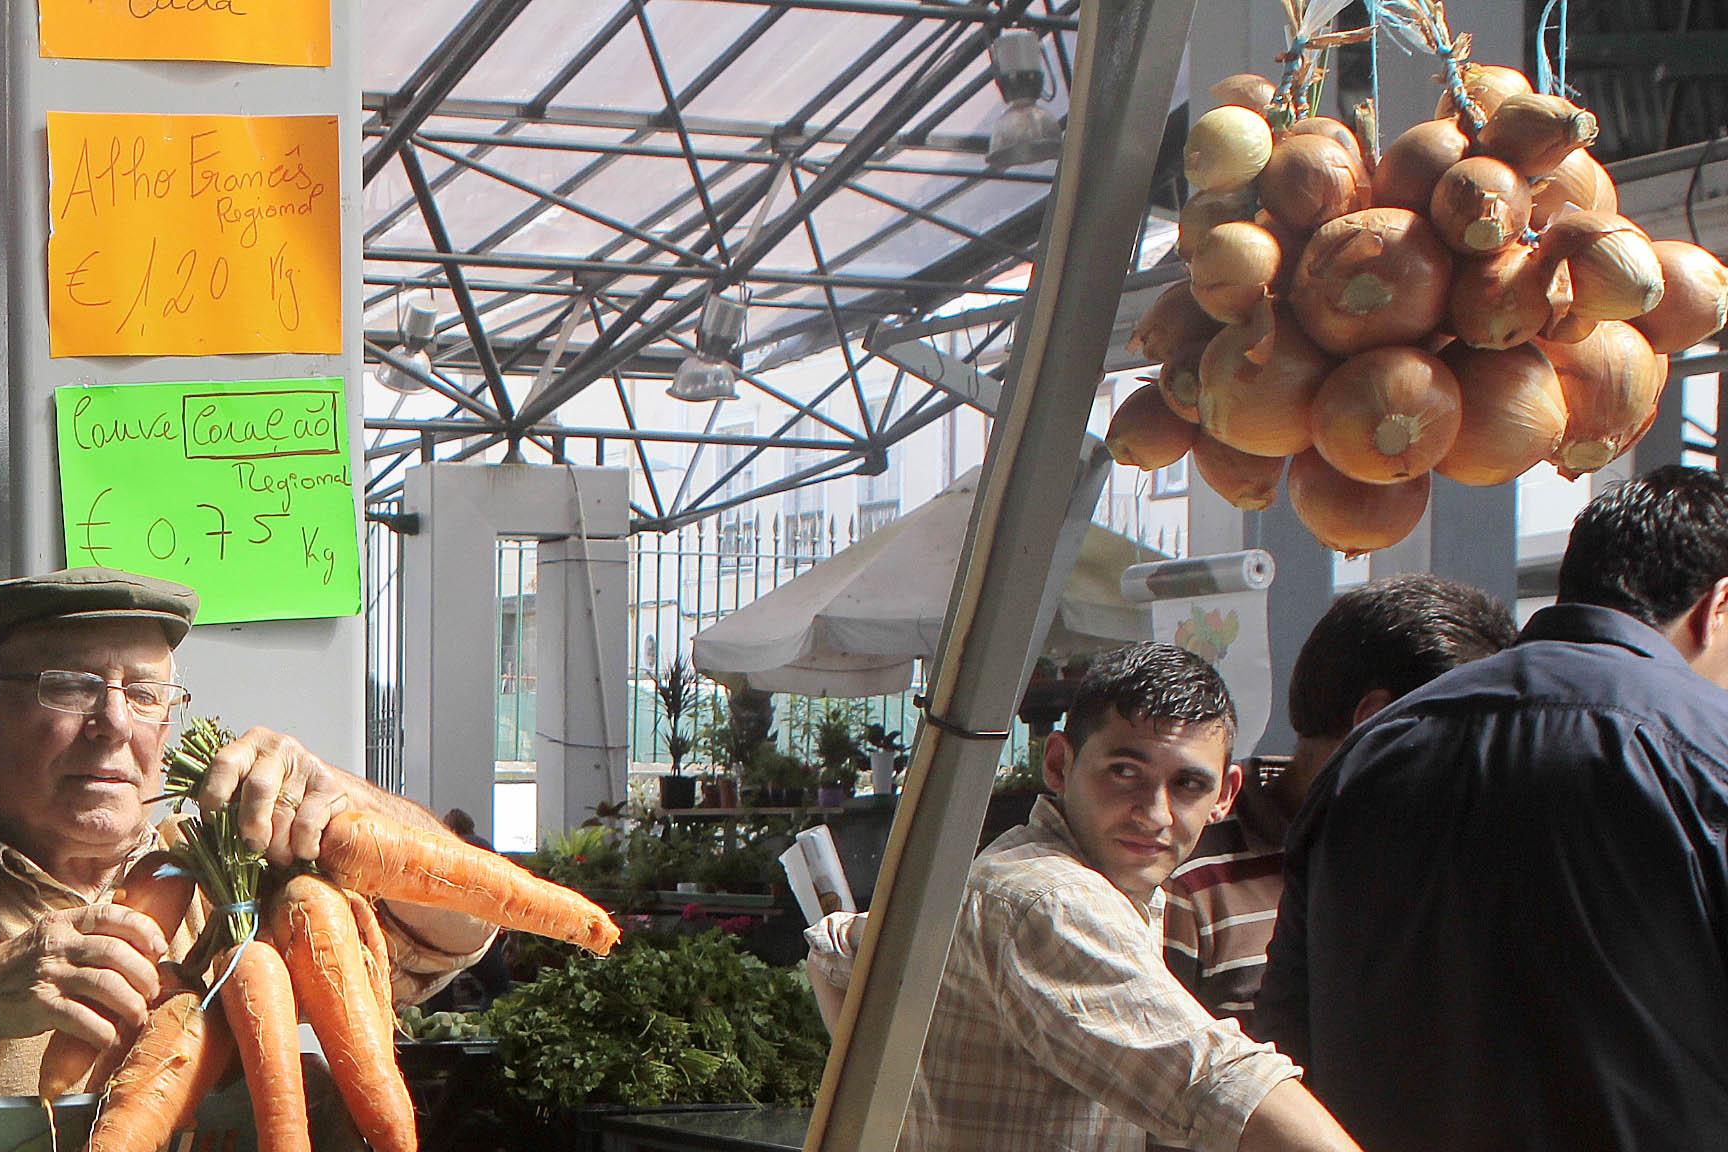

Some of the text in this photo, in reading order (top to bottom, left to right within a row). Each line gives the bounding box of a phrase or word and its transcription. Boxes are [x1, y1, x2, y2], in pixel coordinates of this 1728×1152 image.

[60, 129, 312, 220] Alho Francês
[216, 183, 324, 248] Regional
[65, 250, 112, 306] €
[115, 236, 230, 337] 1,20
[73, 395, 330, 453] Couve Coração
[232, 461, 352, 513] Regional
[75, 487, 336, 586] € 0,75 Kg
